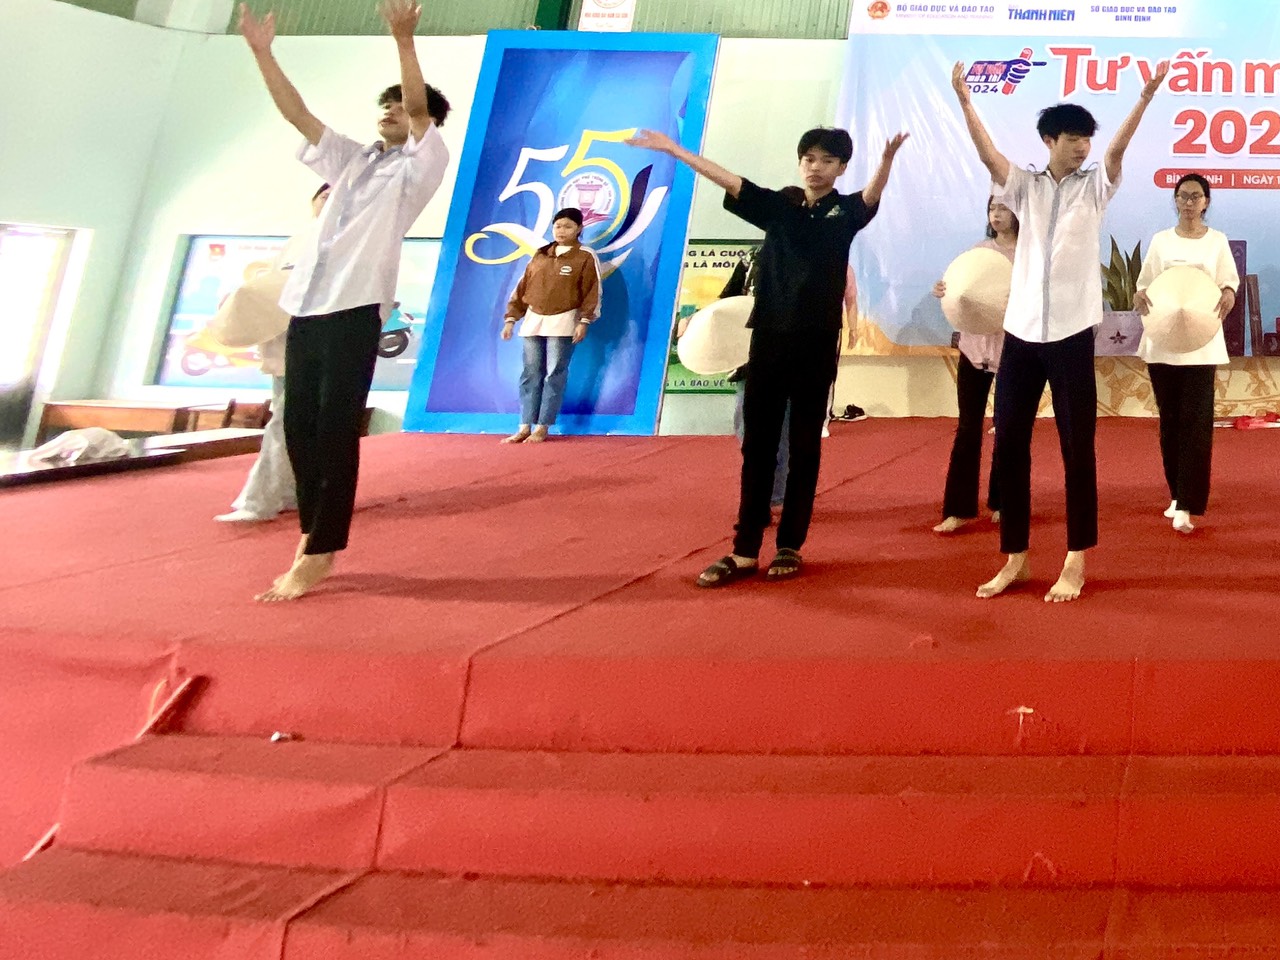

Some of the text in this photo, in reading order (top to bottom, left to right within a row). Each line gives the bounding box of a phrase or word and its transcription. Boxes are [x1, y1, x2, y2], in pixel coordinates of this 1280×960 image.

[1049, 47, 1131, 97] Tư
[1136, 51, 1233, 93] vấn
[1242, 173, 1274, 185] NGÀY
